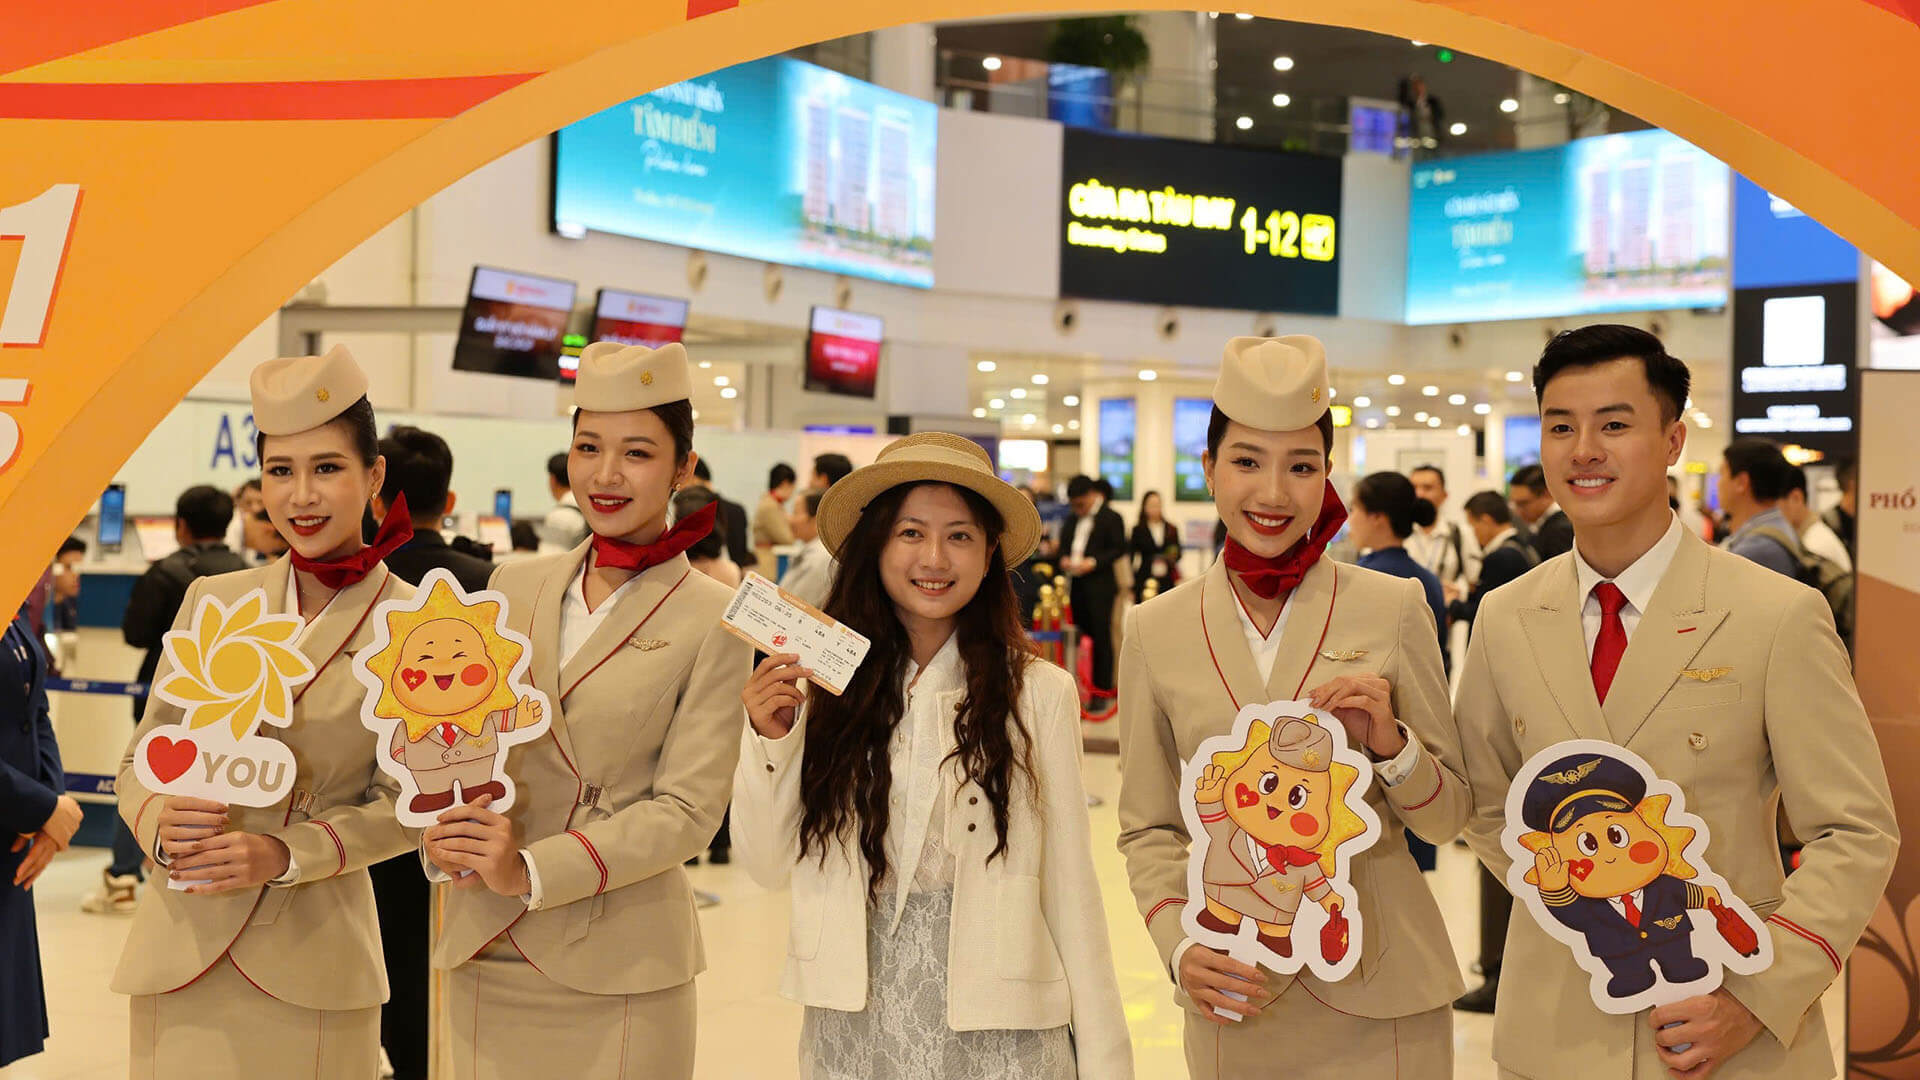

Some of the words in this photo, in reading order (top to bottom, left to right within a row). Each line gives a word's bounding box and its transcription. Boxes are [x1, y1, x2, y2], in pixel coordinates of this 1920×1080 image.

[1240, 206, 1300, 258] 1-12
[1870, 487, 1916, 509] PHỐ
[202, 751, 286, 792] YOU
